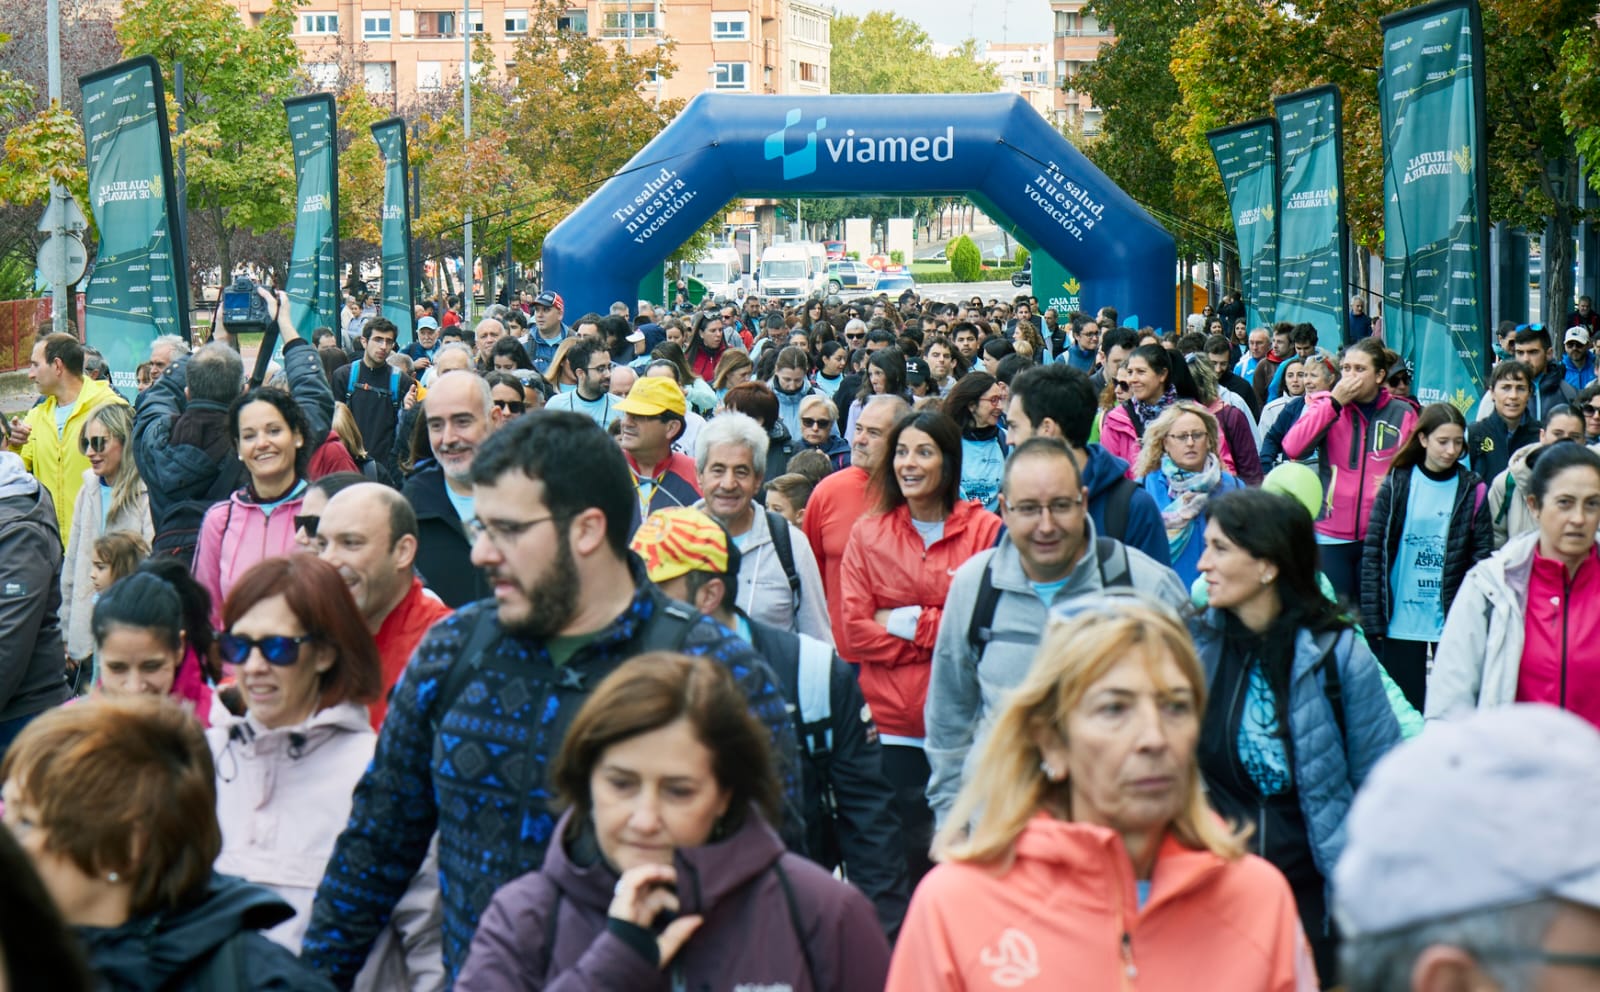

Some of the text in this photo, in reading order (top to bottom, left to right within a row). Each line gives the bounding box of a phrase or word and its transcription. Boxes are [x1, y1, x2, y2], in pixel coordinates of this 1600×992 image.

[825, 126, 954, 163] viamed
[612, 167, 677, 223] Tu salud,
[625, 179, 686, 234] nuestra
[633, 190, 697, 244] vocación.
[1024, 184, 1083, 242] vocación.
[1034, 174, 1095, 230] nuestra
[1045, 160, 1105, 221] Tu salud,
[1049, 297, 1068, 305] CAJA
[1415, 559, 1444, 568] ASPAC
[1418, 552, 1444, 560] March
